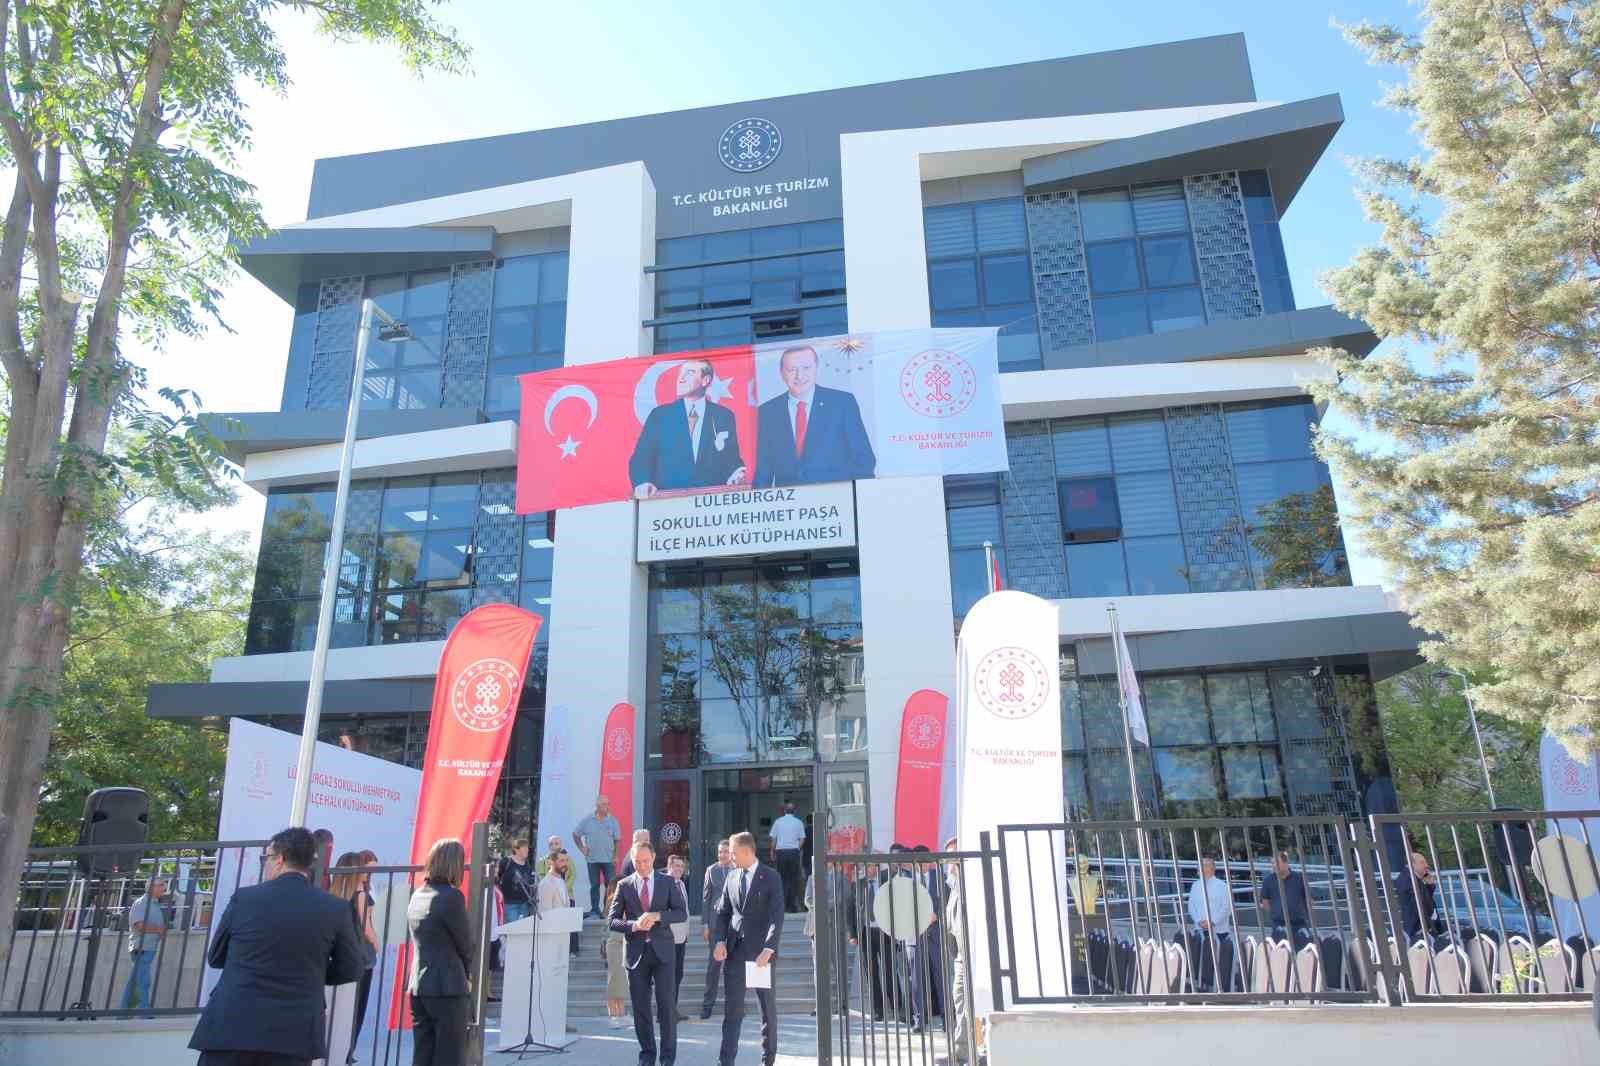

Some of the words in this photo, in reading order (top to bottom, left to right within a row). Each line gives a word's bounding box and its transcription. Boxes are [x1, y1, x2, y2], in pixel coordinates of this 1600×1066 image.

[672, 195, 696, 206] T.C.
[699, 186, 751, 203] KÜLTÜR
[754, 184, 773, 196] VE
[775, 177, 829, 193] TURİZM
[713, 197, 788, 216] BAKANLIĞI
[652, 512, 723, 532] SOKULLU
[726, 509, 795, 526] MEHMET
[798, 505, 839, 523] PAŞA
[650, 537, 681, 554] İLÇE
[685, 534, 727, 550] HALK
[730, 521, 843, 545] KÜTÜPHANESİ
